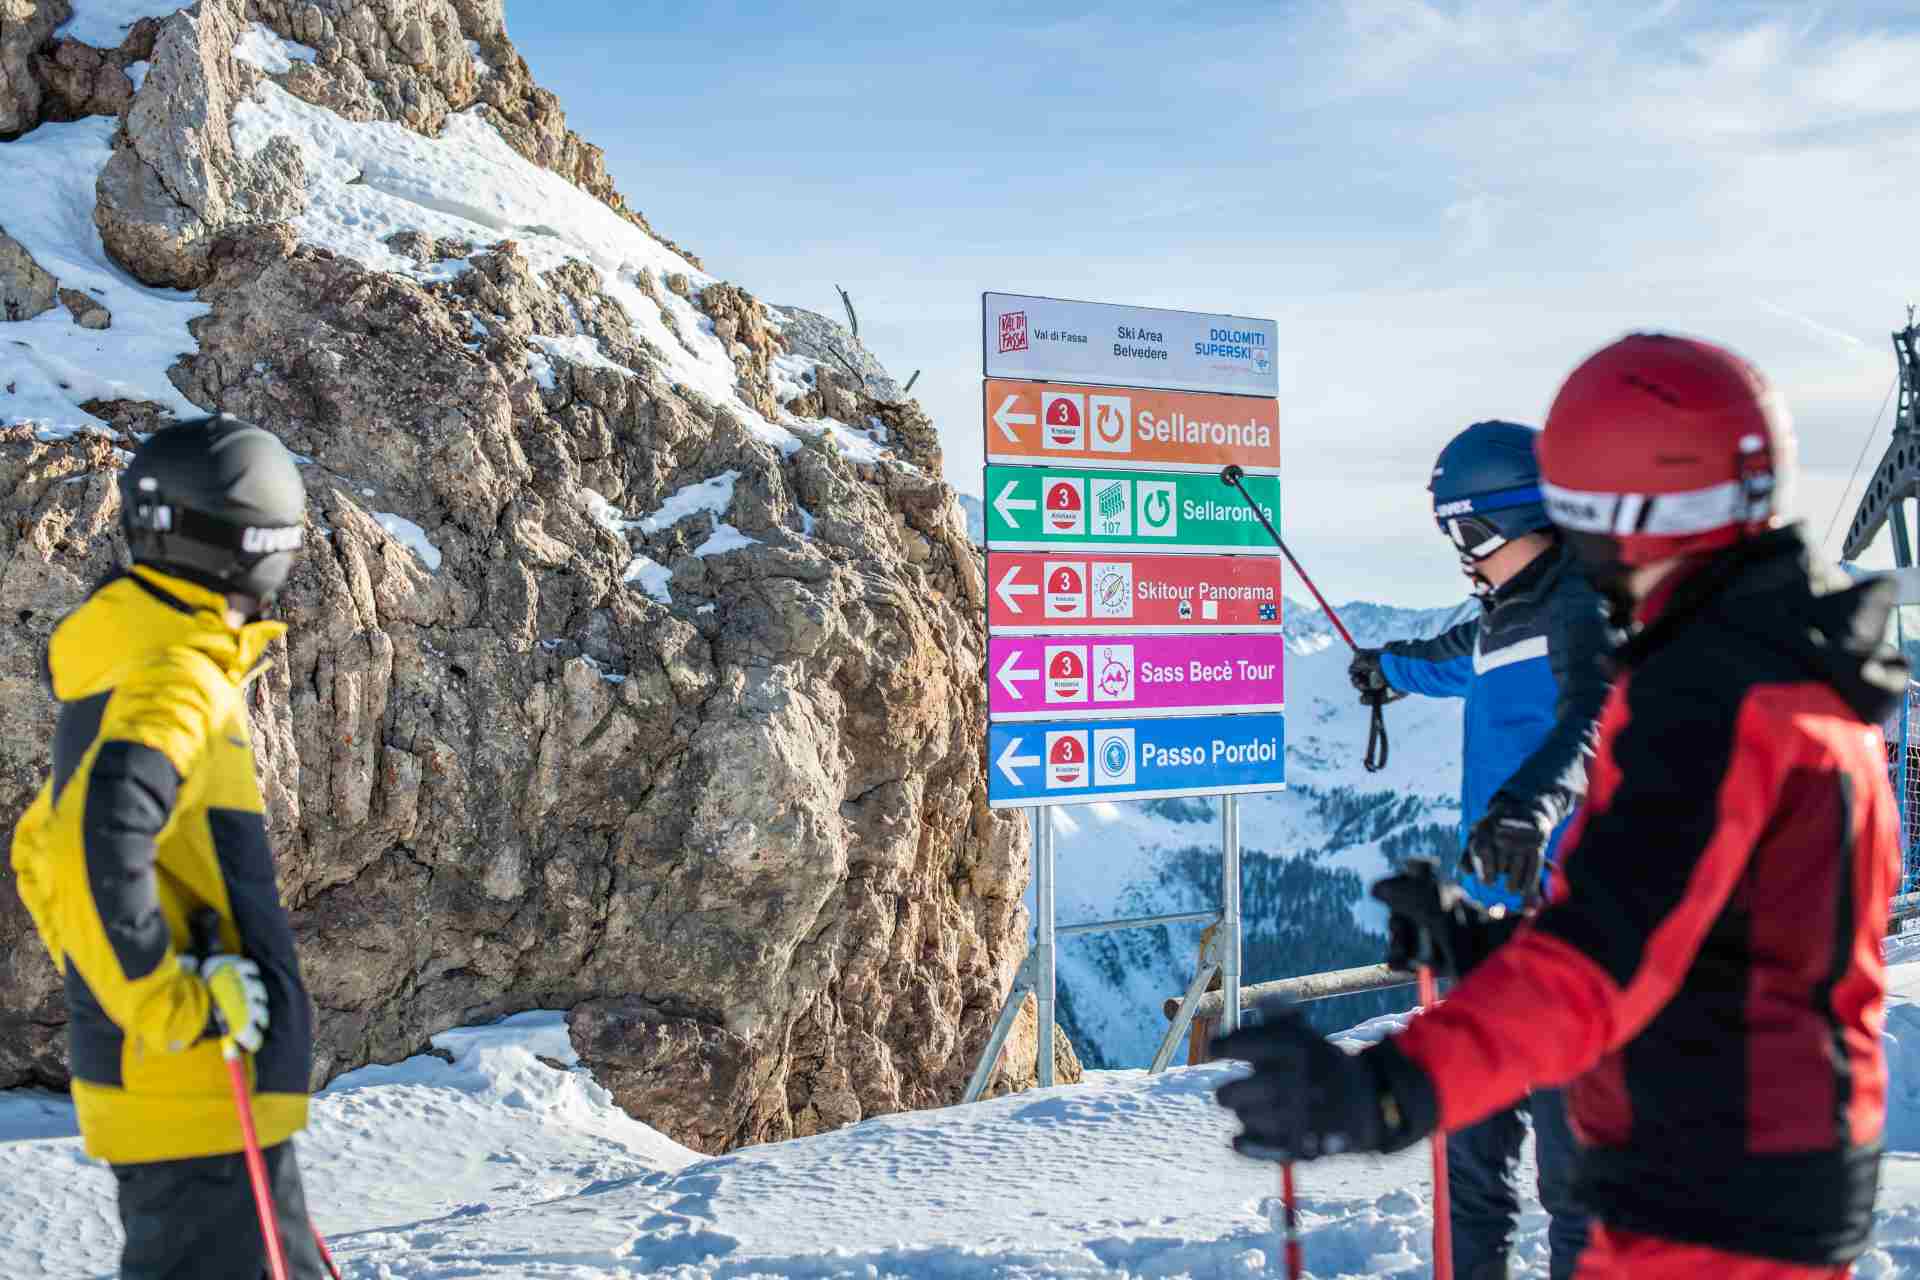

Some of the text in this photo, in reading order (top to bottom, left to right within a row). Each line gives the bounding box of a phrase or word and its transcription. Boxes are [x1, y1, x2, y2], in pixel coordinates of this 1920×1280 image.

[1033, 328, 1087, 343] Val di Fassa
[1118, 326, 1163, 343] Ski Area
[1210, 329, 1265, 346] DOLOMITI
[1113, 343, 1168, 360] Belvedere
[1194, 342, 1251, 360] SUPERSKI
[1058, 403, 1069, 423] 3
[1137, 410, 1271, 448] Sellaronda
[1059, 488, 1069, 507] 3
[1102, 521, 1121, 534] 107
[1060, 572, 1071, 591] 3
[1137, 580, 1274, 600] Skitour Panorama
[1061, 656, 1073, 676] 3
[1141, 660, 1276, 683] Sass Becè Tour
[1062, 742, 1073, 761] 3
[1141, 737, 1277, 768] Passo Pordoi
